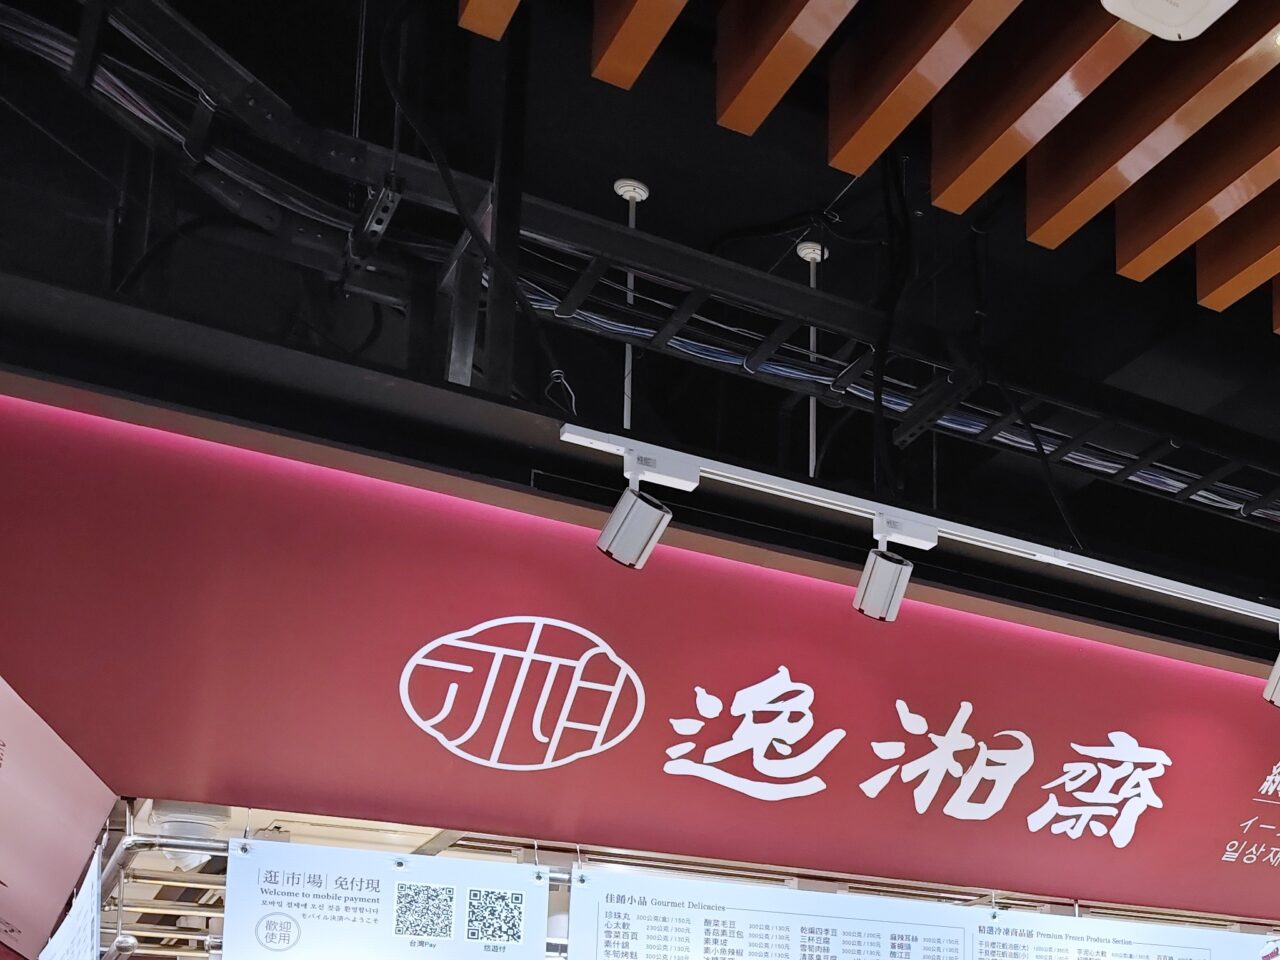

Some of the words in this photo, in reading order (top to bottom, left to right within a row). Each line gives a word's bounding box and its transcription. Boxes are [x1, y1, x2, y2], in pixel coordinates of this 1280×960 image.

[663, 666, 1173, 848] 逸湘齋
[334, 876, 380, 892] 免付現
[260, 888, 299, 898] Welcome
[312, 892, 342, 901] mobile
[344, 896, 380, 904] payment
[651, 898, 685, 908] Gourmet
[688, 902, 726, 912] Delicacies
[265, 933, 290, 944] 使用
